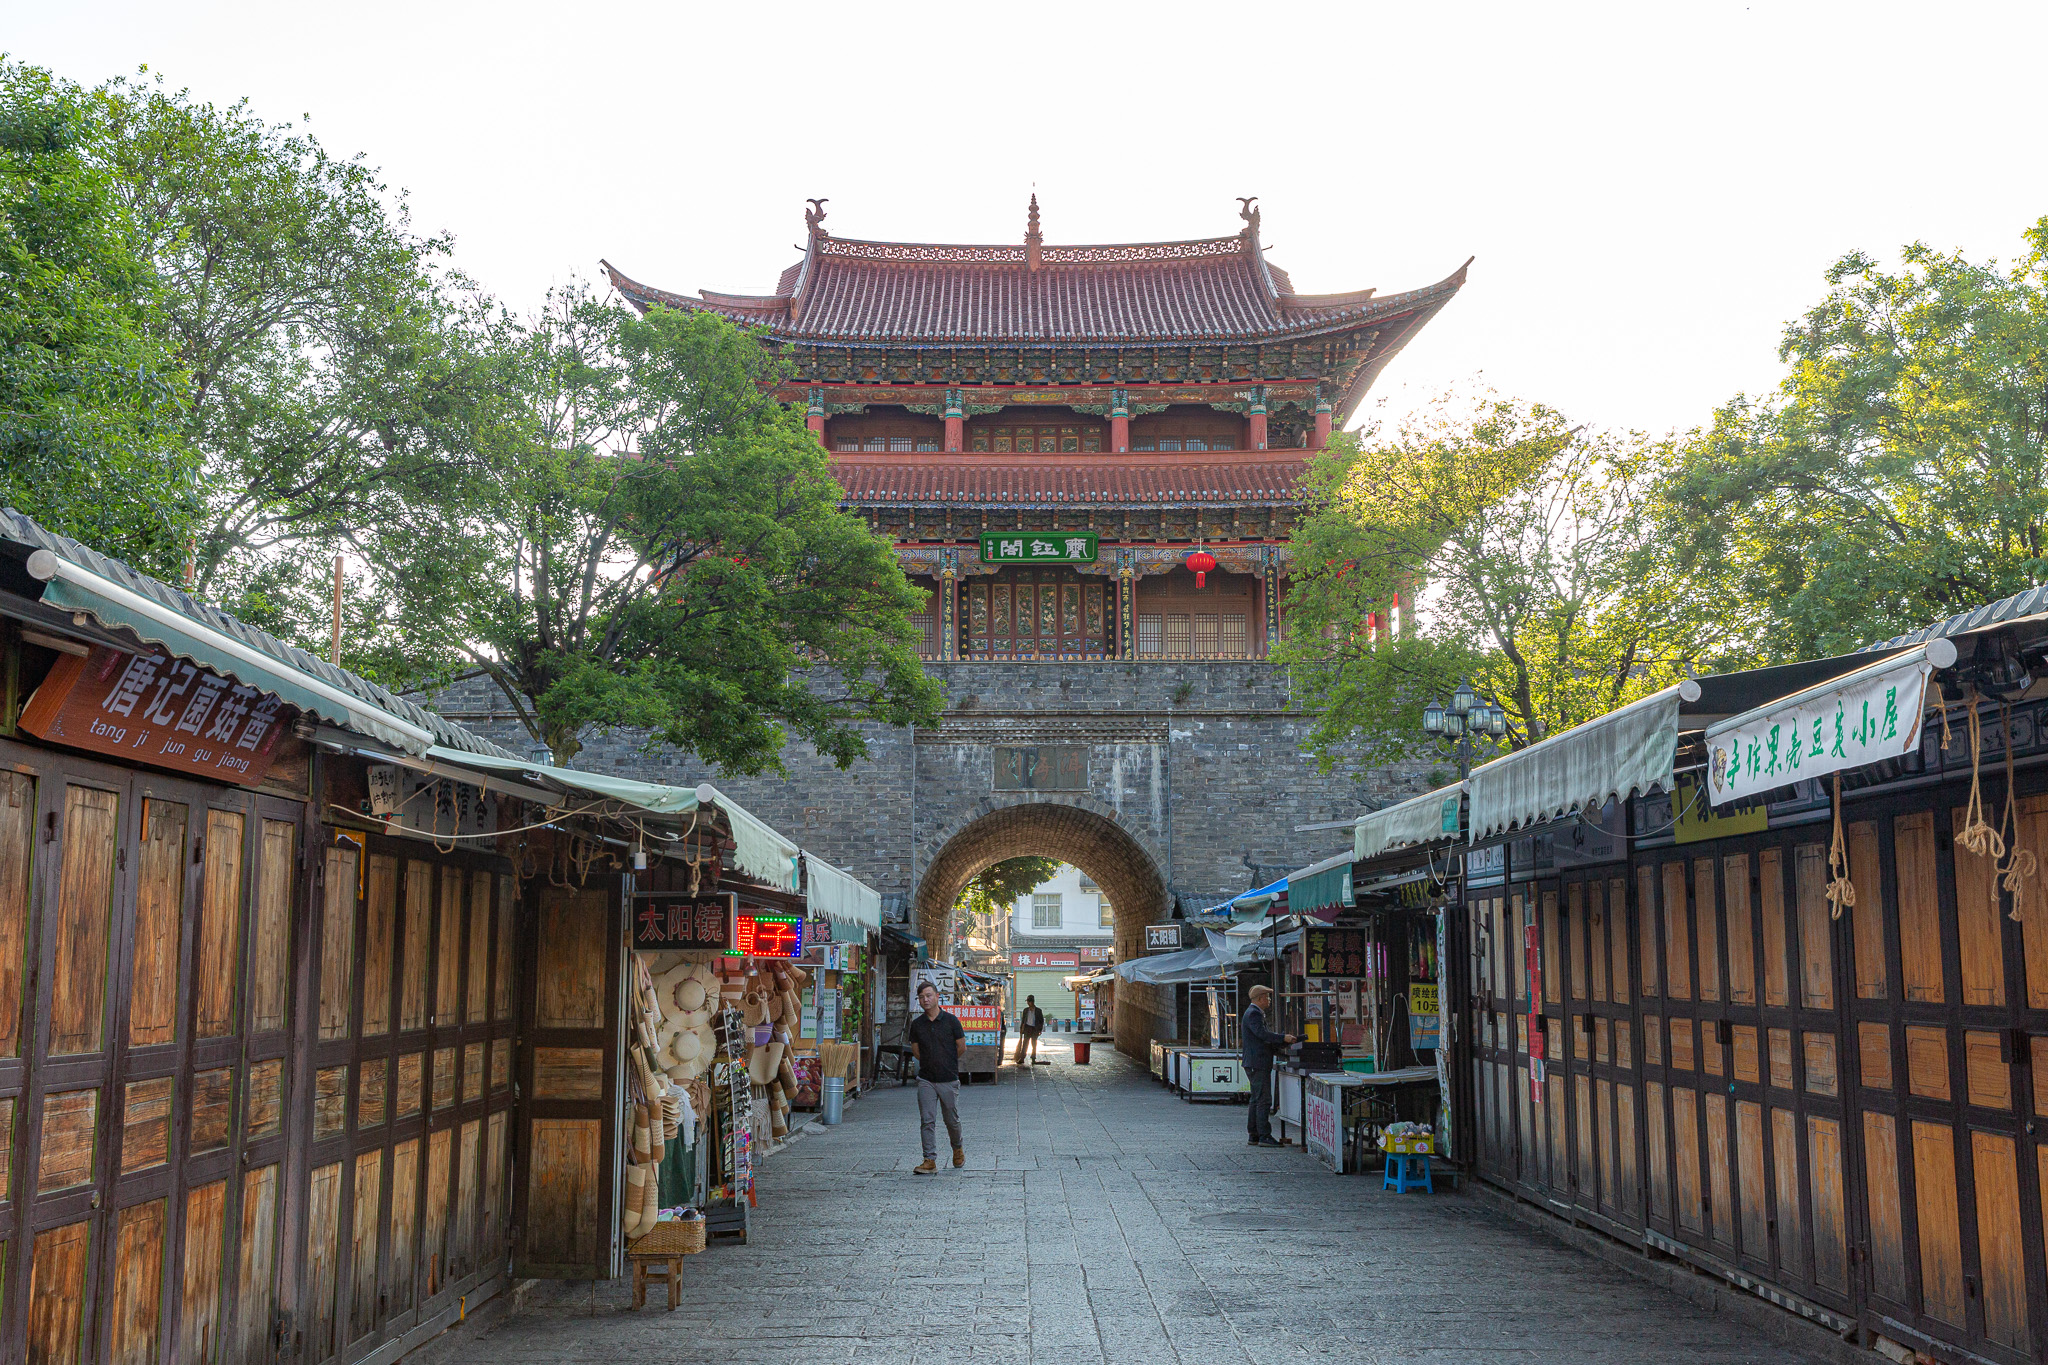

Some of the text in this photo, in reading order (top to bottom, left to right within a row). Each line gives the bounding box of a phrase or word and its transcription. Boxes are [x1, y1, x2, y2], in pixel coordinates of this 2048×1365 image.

[90, 717, 250, 774] tang ji jun gu jiang
[638, 902, 724, 943] 太阳镜
[1150, 929, 1178, 946] 太阳镜
[1309, 931, 1327, 974] 专业
[1417, 1000, 1439, 1012] 10元
